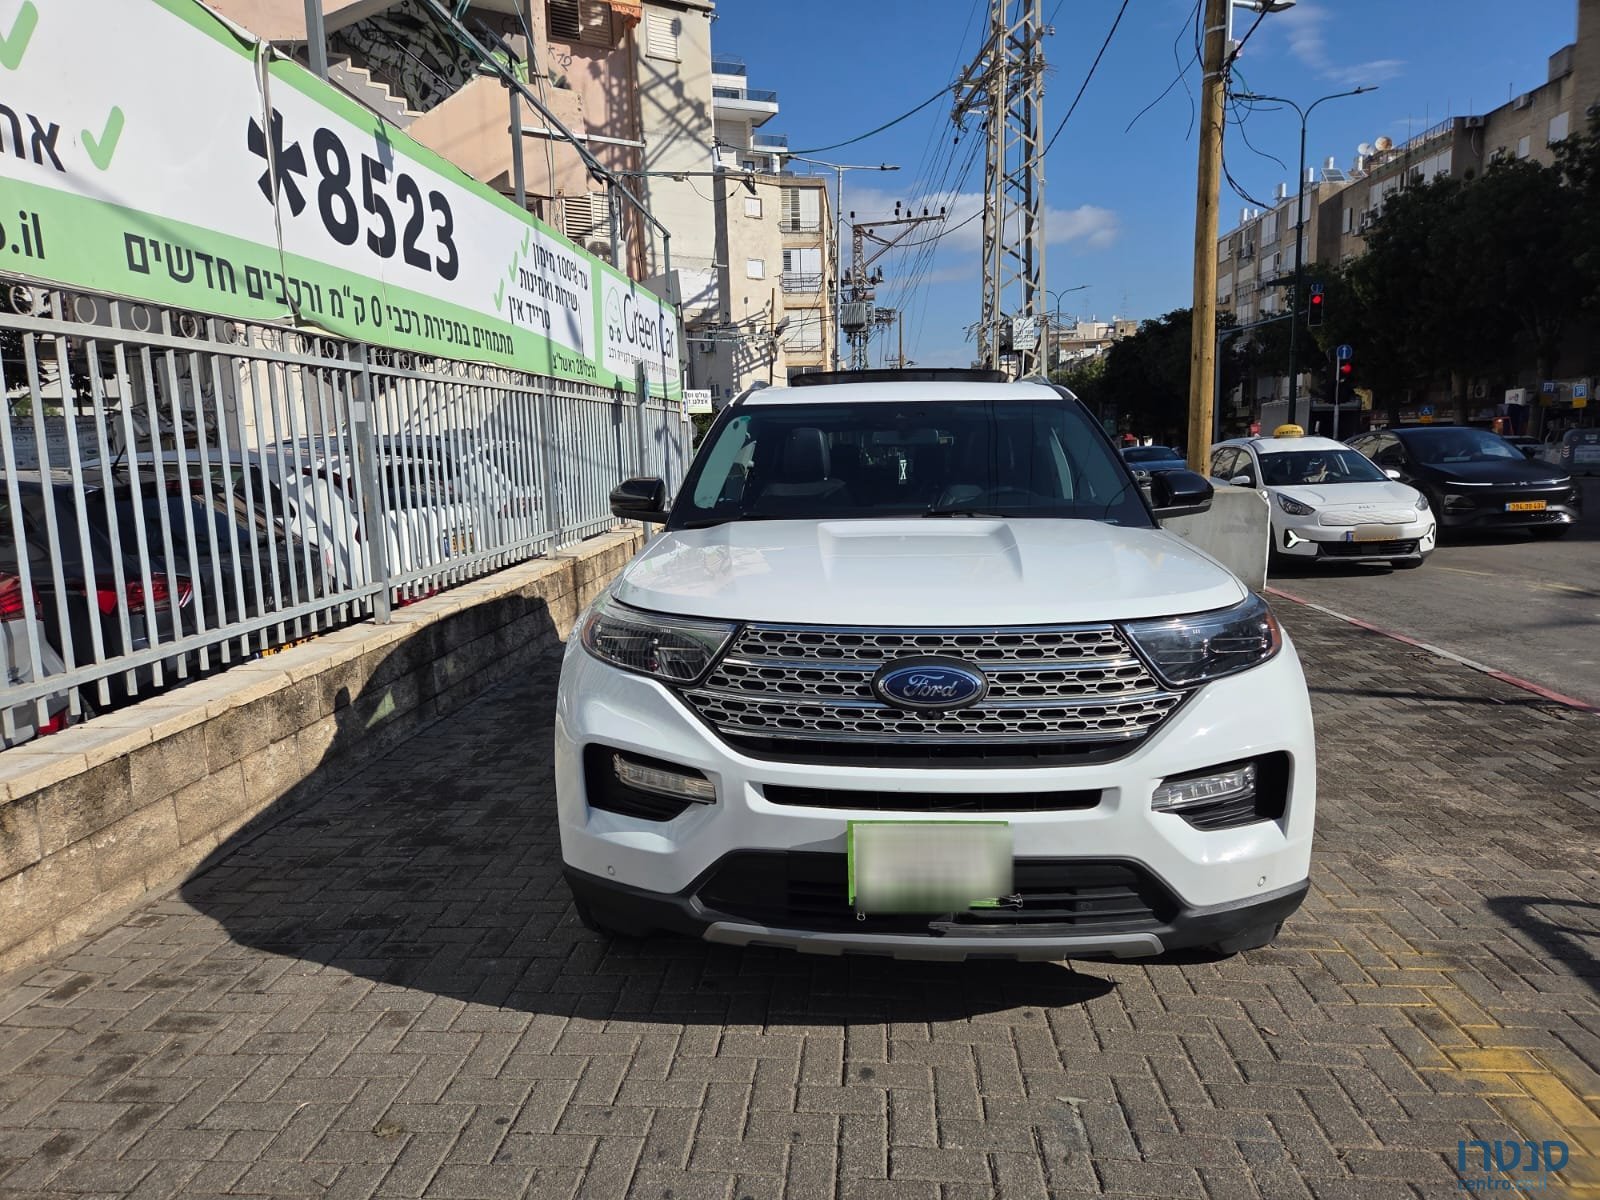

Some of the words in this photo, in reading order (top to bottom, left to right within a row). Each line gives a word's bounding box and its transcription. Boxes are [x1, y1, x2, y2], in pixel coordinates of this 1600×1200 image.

[0, 210, 45, 260] .il
[124, 231, 237, 294] חדשים
[532, 242, 555, 273] מימון
[557, 254, 578, 285] 100%
[244, 265, 323, 314] ורכבים
[519, 267, 554, 302] ואמינות
[578, 270, 588, 290] עד
[371, 295, 382, 327] 0
[508, 295, 524, 325] אין
[555, 285, 578, 312] שירות
[386, 305, 421, 336] רכבי
[423, 314, 471, 346] במכירת
[526, 302, 551, 330] טרייד
[624, 293, 658, 352] Green
[659, 312, 674, 359] Car
[472, 326, 514, 355] מתמחים
[903, 674, 958, 697] Ford
